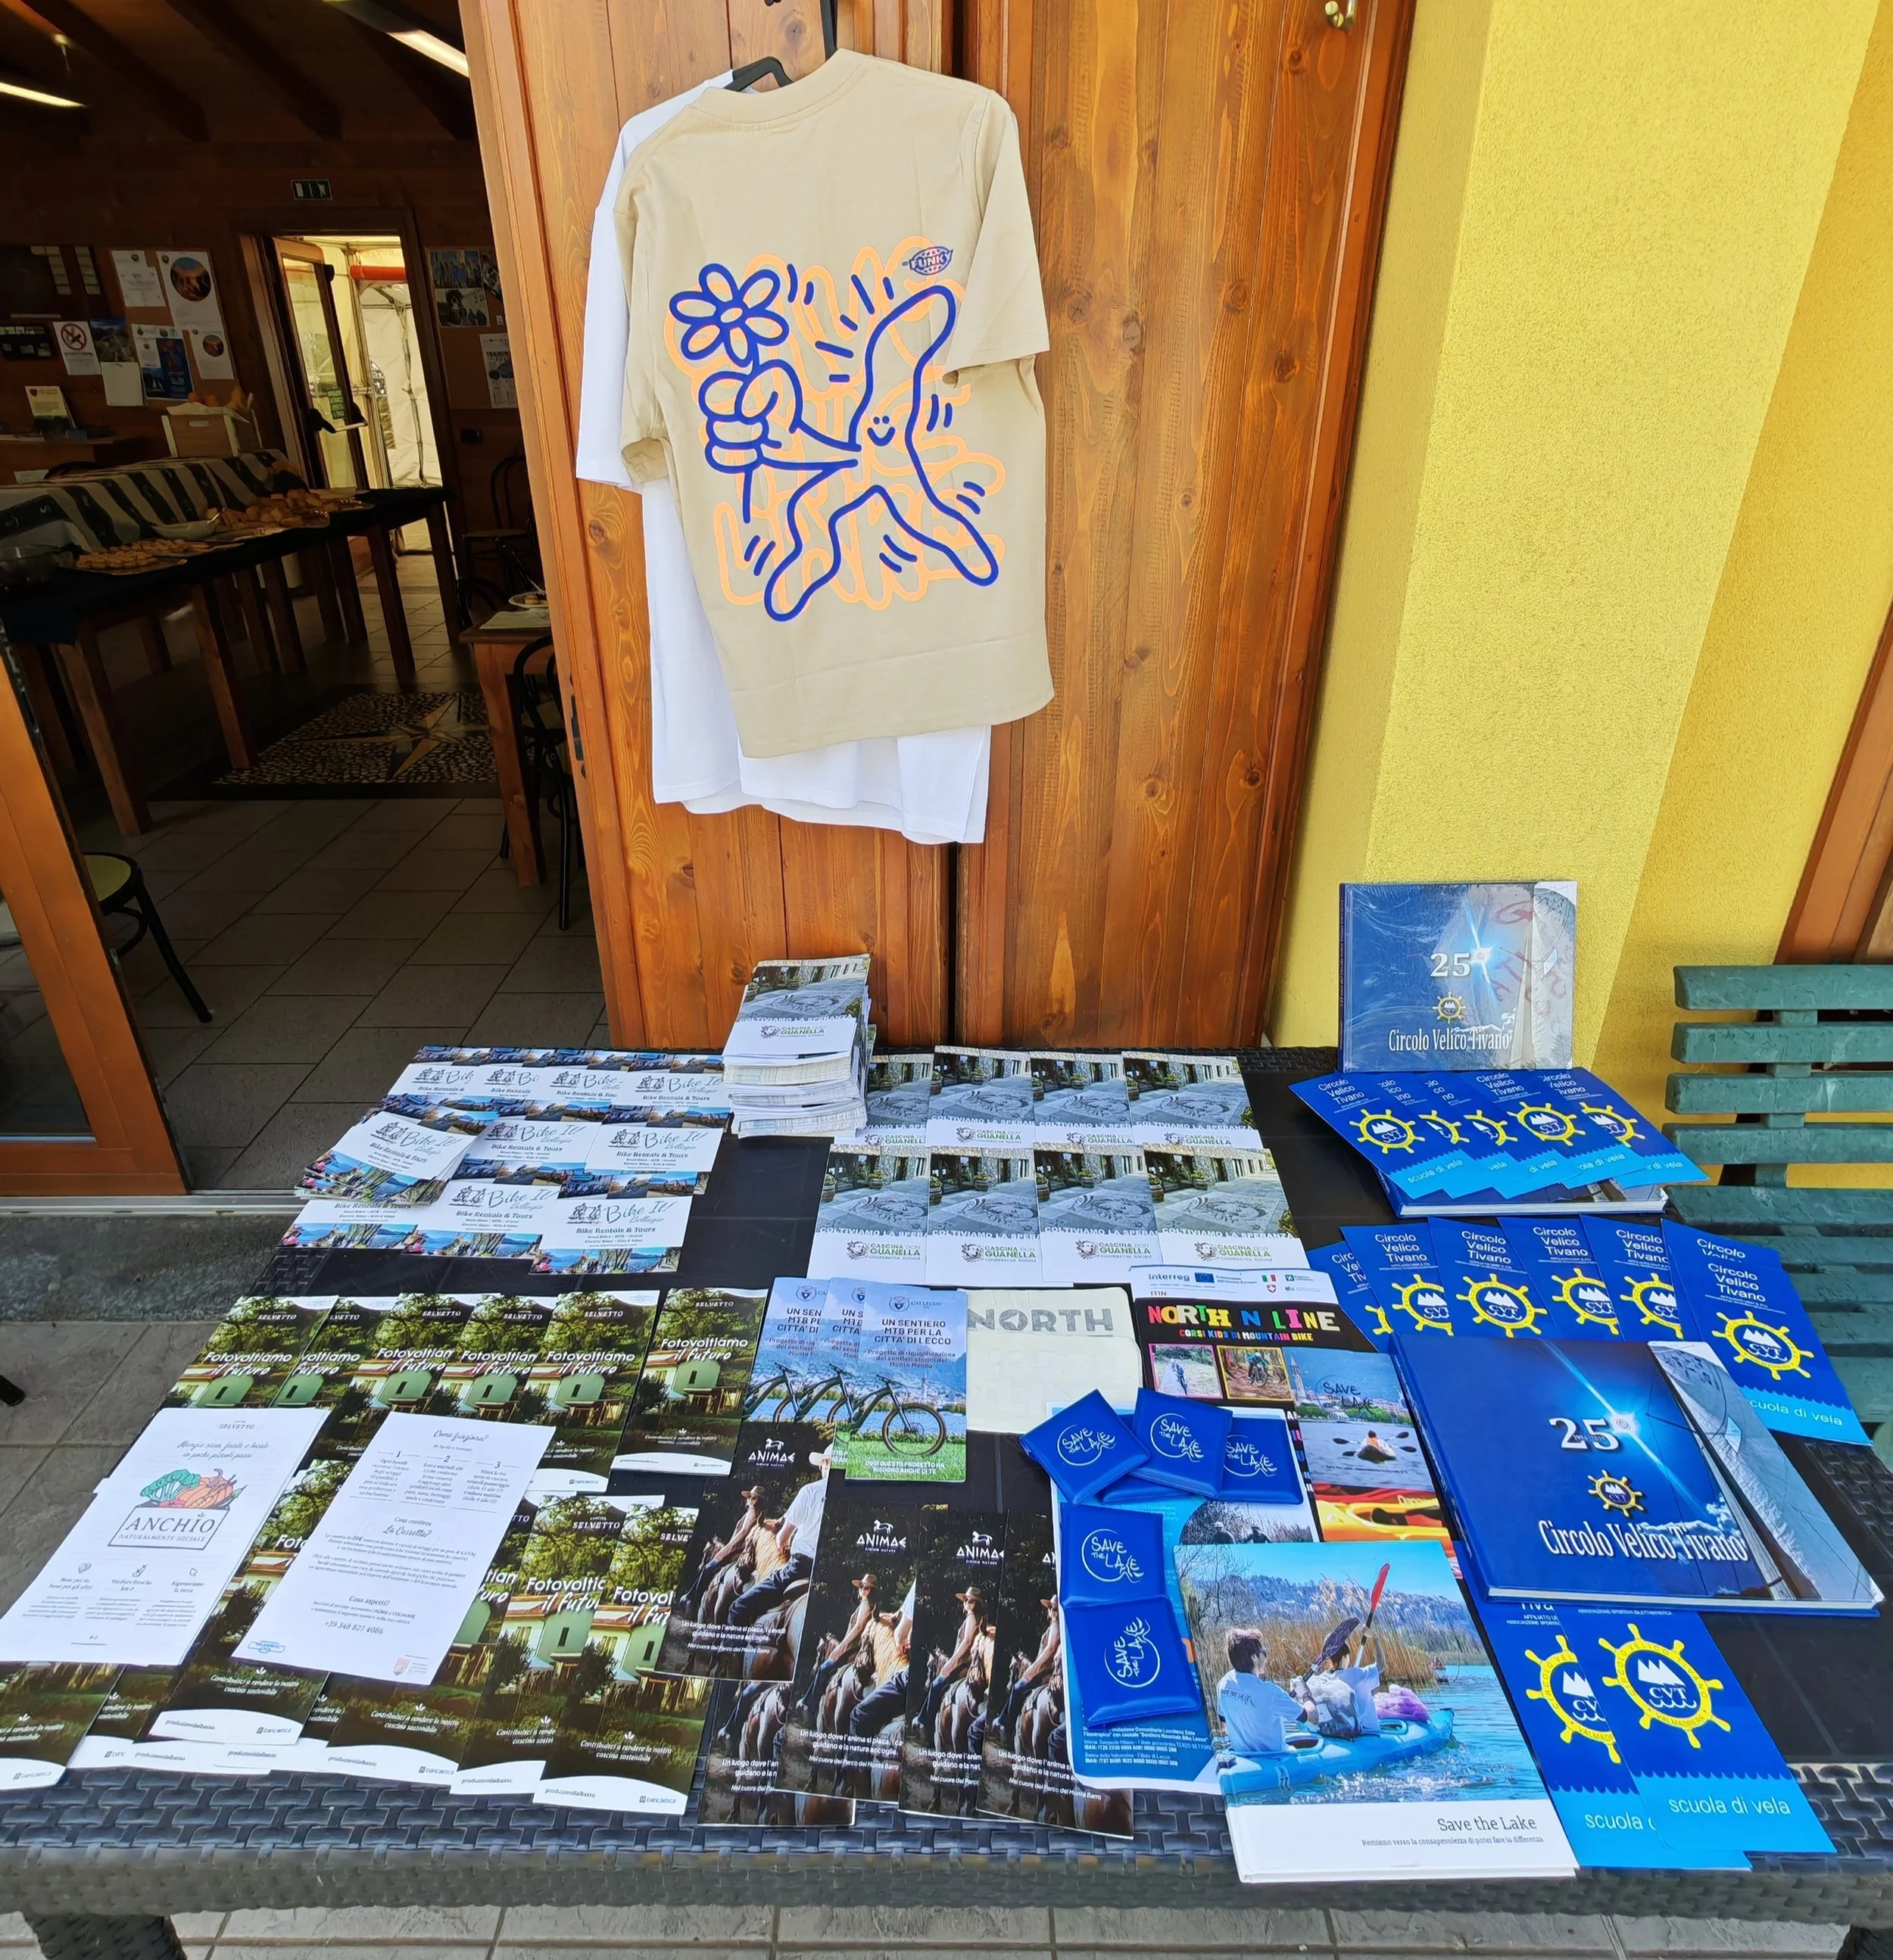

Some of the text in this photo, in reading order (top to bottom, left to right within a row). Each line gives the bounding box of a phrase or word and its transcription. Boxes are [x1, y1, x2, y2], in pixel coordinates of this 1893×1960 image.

[1389, 1030, 1429, 1051] Circolo
[1470, 1029, 1510, 1049] Tivano
[1477, 1072, 1508, 1083] Circolo
[1485, 1079, 1514, 1089] Velico
[1318, 1079, 1349, 1091] Circolo
[1327, 1086, 1355, 1097] Velico
[1491, 1086, 1524, 1096] Tivano
[1333, 1092, 1364, 1105] Tivano
[1408, 1159, 1463, 1183] scuola di vela
[820, 1227, 881, 1236] COLTIVIAMO
[1162, 1227, 1221, 1237] COLTIVIAMO
[1461, 1230, 1506, 1244] Circolo
[1533, 1226, 1576, 1236] Circolo
[1617, 1229, 1663, 1244] Circolo
[1375, 1233, 1417, 1243] Circolo
[1541, 1236, 1580, 1246] Velico
[1381, 1243, 1420, 1251] Velico
[1467, 1241, 1506, 1254] Velico
[1545, 1246, 1588, 1256] Tivano
[1623, 1240, 1664, 1254] Velico
[1697, 1238, 1746, 1258] Circolo
[1386, 1253, 1427, 1262] Tivano
[1467, 1250, 1511, 1264] Tivano
[1149, 1273, 1190, 1281] Interreg
[1708, 1264, 1757, 1281] Circolo
[1715, 1273, 1759, 1291] Velico
[1717, 1284, 1766, 1302] Tivano
[968, 1308, 1113, 1332] NORTH
[1147, 1304, 1341, 1332] NORTH N LINE
[875, 1335, 905, 1344] CITTA'
[1179, 1329, 1314, 1341] CORSI KIDS DI MOUNTAIN BIKE
[661, 1338, 748, 1348] Fotovoltiamo
[204, 1351, 292, 1362] Fotovoltiamo
[547, 1350, 635, 1362] Fotovoltiamo
[675, 1348, 731, 1363] il futuro
[226, 1363, 270, 1377] futuro
[559, 1362, 616, 1376] il futuro
[1323, 1382, 1361, 1396] SAVE
[1748, 1401, 1843, 1426] cuola di vela
[1161, 1419, 1192, 1437] SAVE
[1062, 1428, 1093, 1449] SAVE
[1226, 1442, 1258, 1454] SAVE
[125, 1516, 215, 1534] ANCHIO
[1092, 1537, 1127, 1553] SAVE
[1539, 1520, 1748, 1562] Circolo Velico Tivano
[366, 1626, 384, 1634] 4086
[1115, 1636, 1132, 1678] SAVE
[1649, 1687, 1687, 1700] CVT
[809, 1732, 827, 1740] luogo
[812, 1740, 837, 1750] guidano
[1669, 1798, 1791, 1815] scuola di vela
[1437, 1815, 1537, 1831] Save the Lake
[1586, 1813, 1644, 1831] scuola
[1513, 1835, 1543, 1843] differenza
